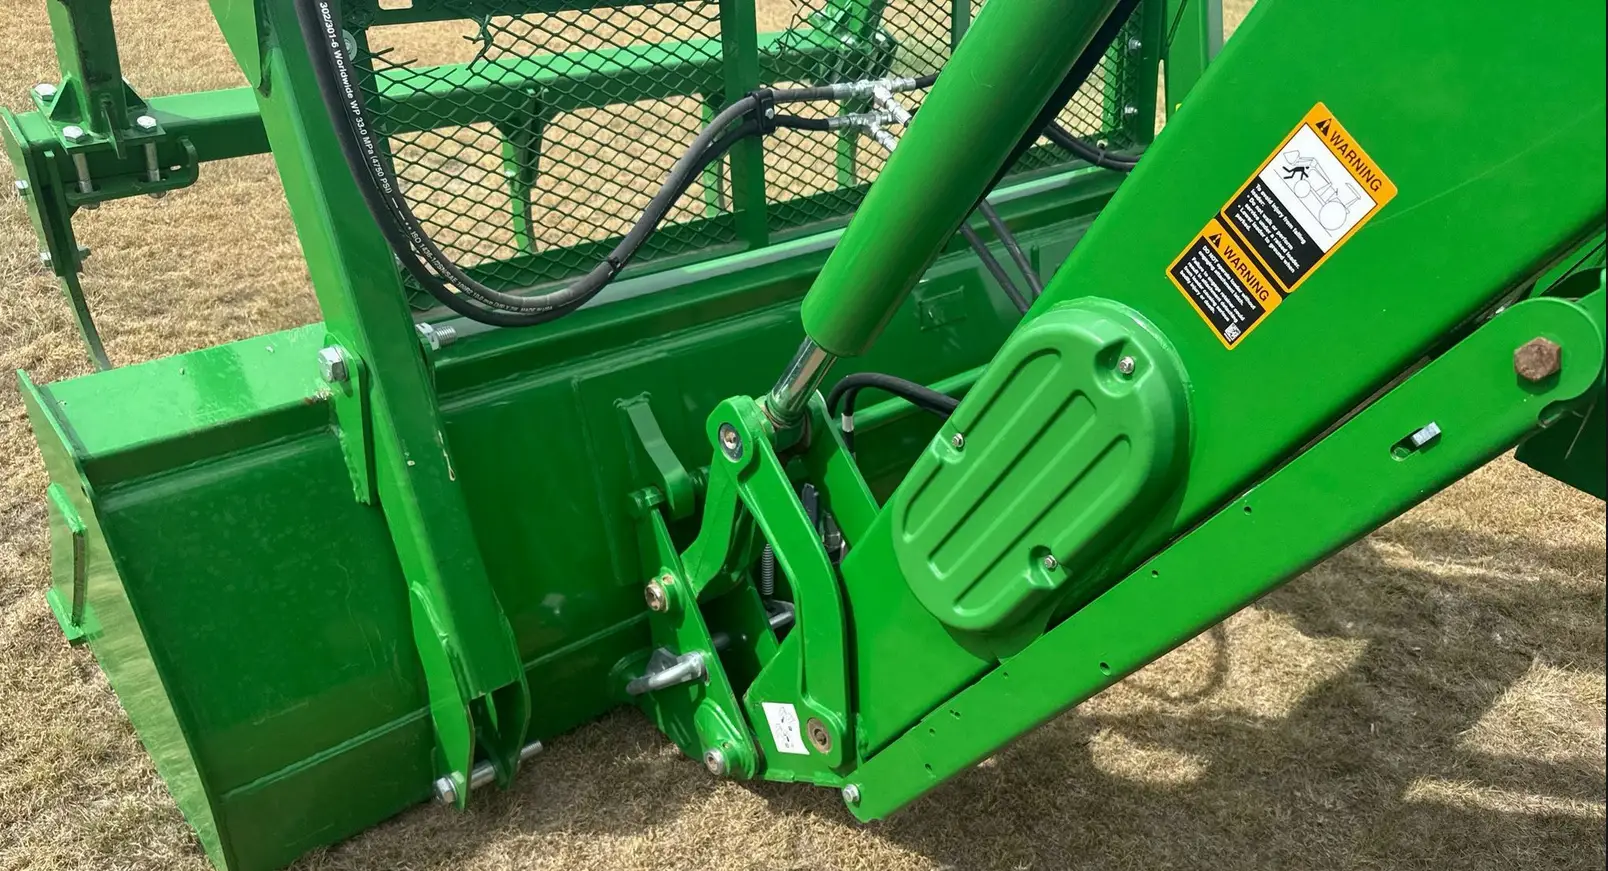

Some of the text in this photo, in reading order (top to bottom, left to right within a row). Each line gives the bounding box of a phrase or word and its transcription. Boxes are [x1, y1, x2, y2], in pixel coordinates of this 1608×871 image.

[320, 1, 393, 194] 302/301-6 Worldwide WP 33.0 MPa (4750 PSI)
[1328, 130, 1383, 192] WARNING
[1234, 212, 1251, 232] parked.
[1248, 197, 1256, 206] Do
[1254, 204, 1263, 214] not
[1261, 212, 1273, 226] walk
[1275, 229, 1294, 250] perform
[1250, 188, 1266, 206] loader:
[1255, 183, 1306, 245] To avoid injury from falling
[411, 231, 422, 243] ISO
[1239, 207, 1295, 273] Lower loader to ground when
[1244, 202, 1260, 220] service
[1258, 219, 1271, 234] under
[1272, 236, 1287, 253] raised
[1285, 251, 1301, 269] loader.
[1191, 256, 1205, 272] Failure
[1206, 275, 1221, 293] engage
[1219, 290, 1235, 308] retainer
[1233, 307, 1245, 321] could
[1202, 244, 1256, 310] DO NOT operate loader without
[1222, 245, 1270, 302] WARNING
